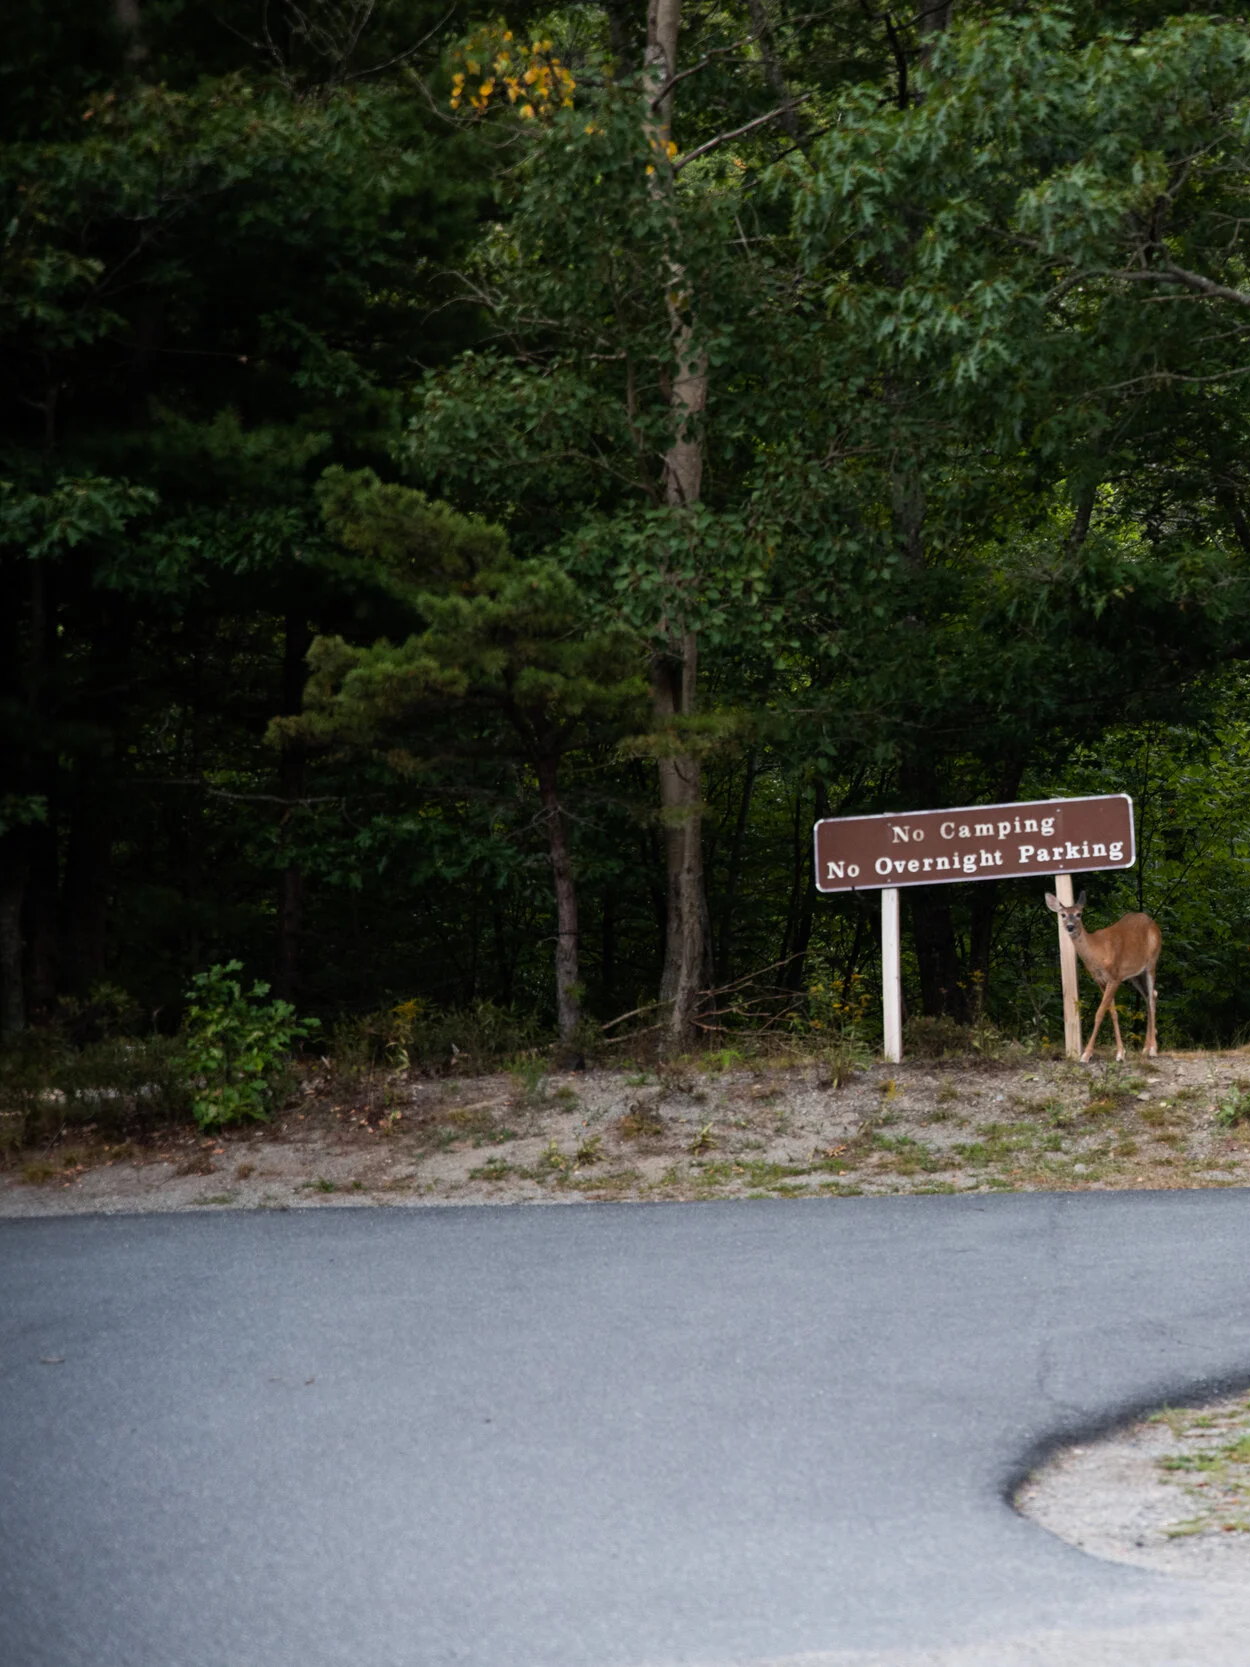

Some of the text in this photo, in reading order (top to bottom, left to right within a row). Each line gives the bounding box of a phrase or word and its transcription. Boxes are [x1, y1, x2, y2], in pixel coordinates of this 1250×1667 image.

[892, 816, 1055, 843] No Camping
[827, 840, 1124, 879] No Overnight Parking
